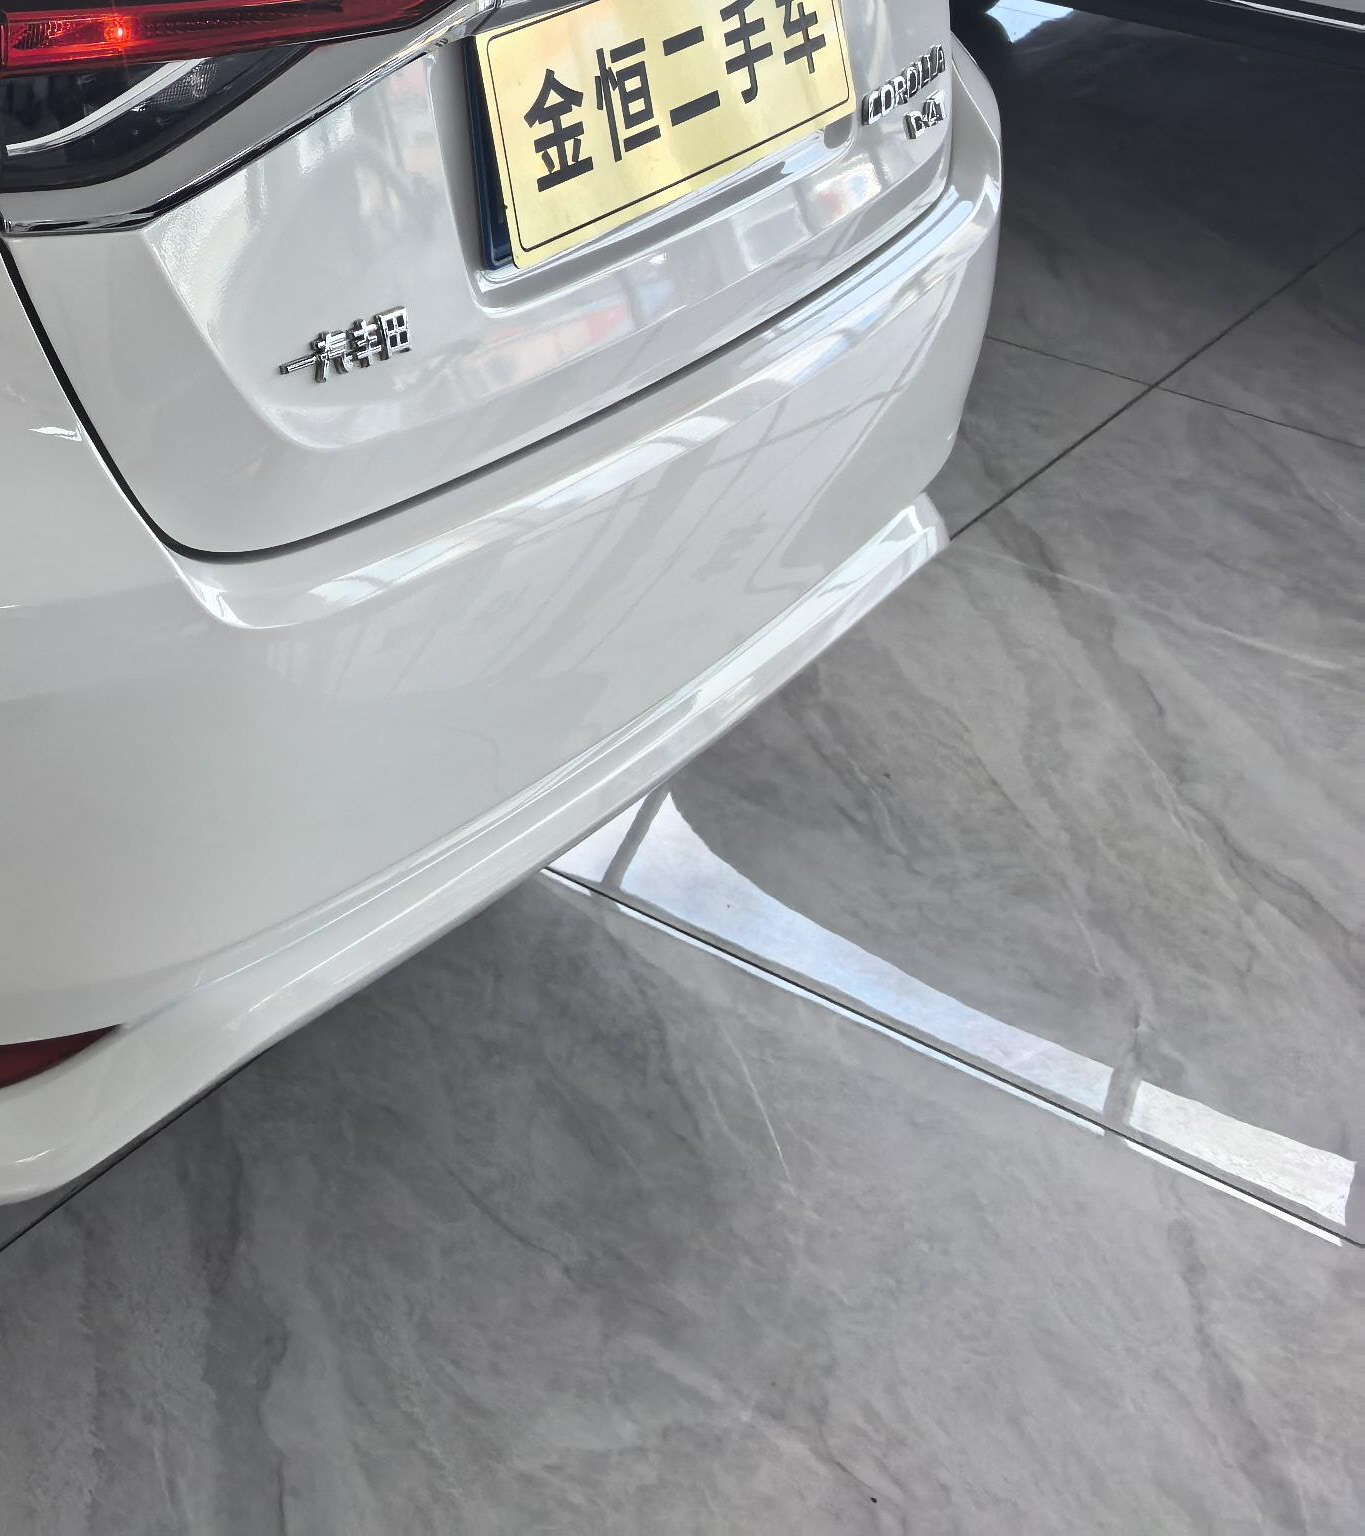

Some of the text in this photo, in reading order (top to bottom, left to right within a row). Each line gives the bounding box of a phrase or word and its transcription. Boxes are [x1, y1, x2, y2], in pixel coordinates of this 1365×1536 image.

[862, 44, 946, 125] COROLLA
[279, 305, 411, 383] 一汽丰田
